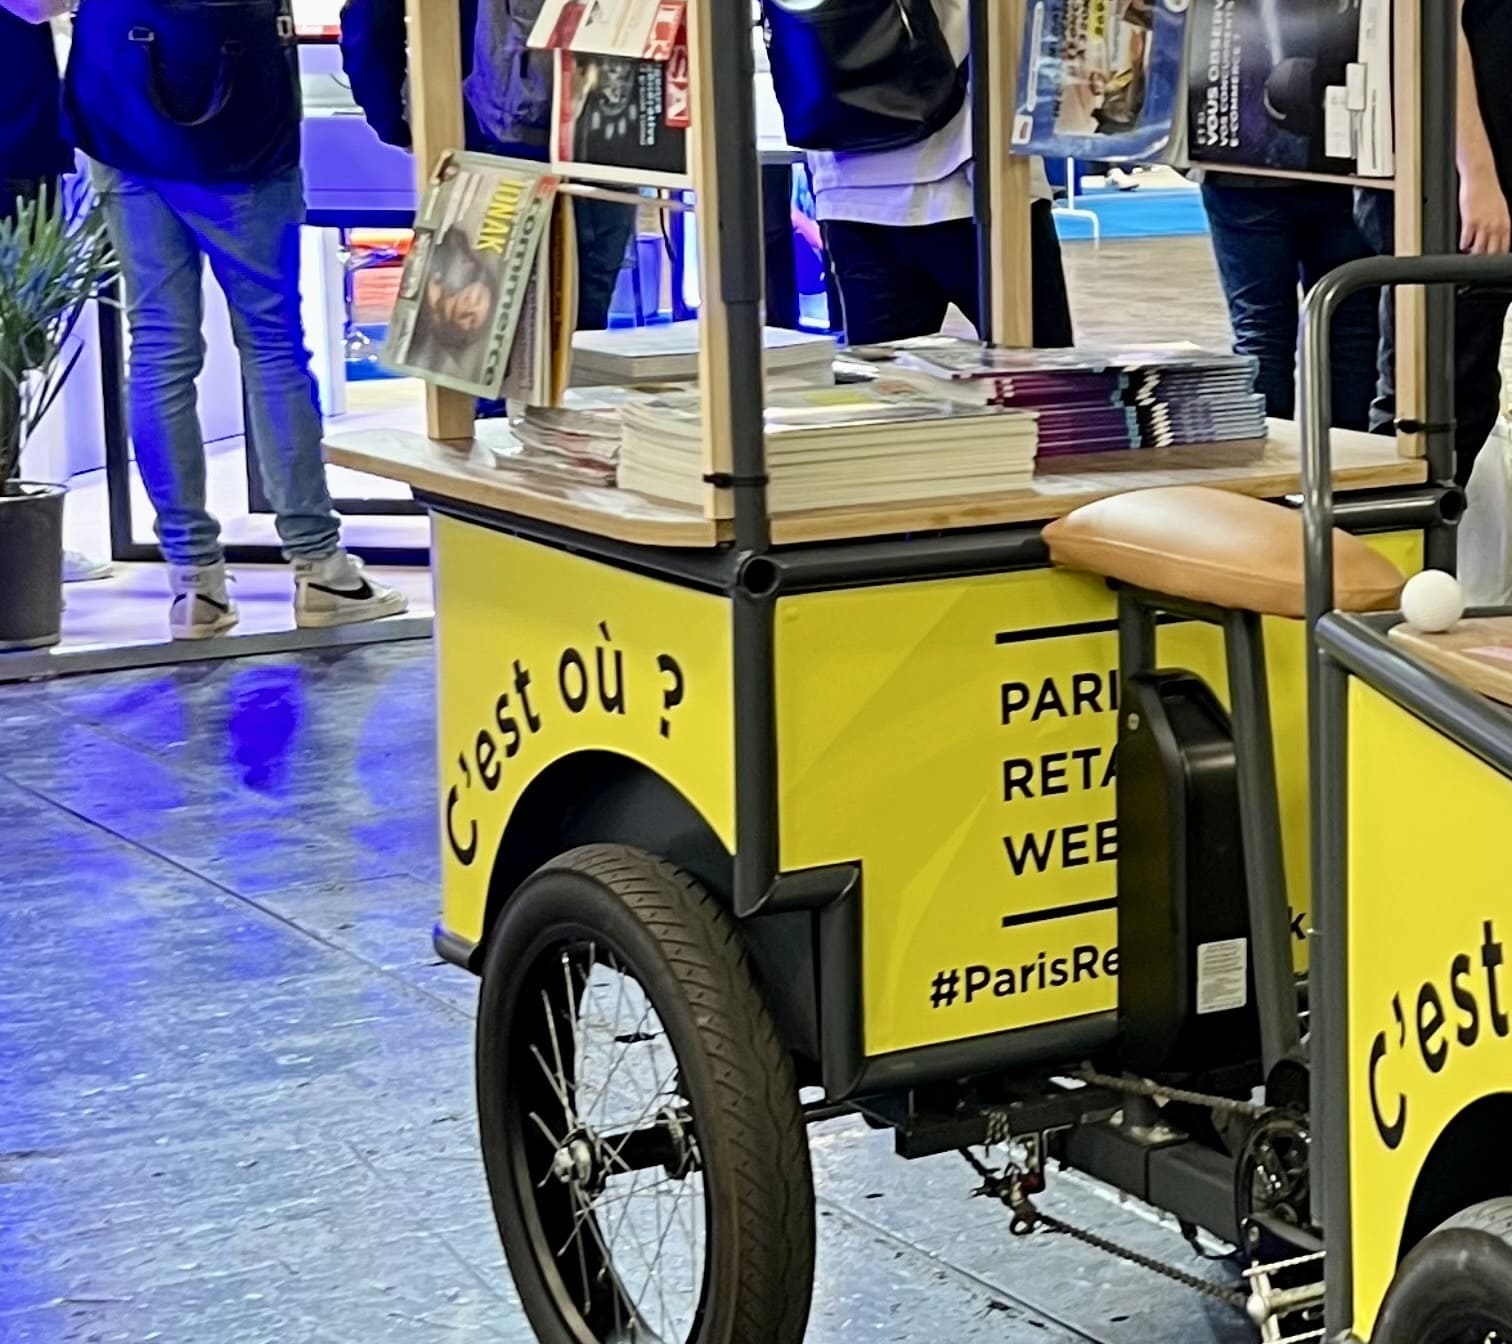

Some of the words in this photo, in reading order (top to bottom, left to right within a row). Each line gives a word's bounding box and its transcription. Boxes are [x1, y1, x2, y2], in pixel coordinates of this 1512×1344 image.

[1207, 85, 1220, 146] VOUS
[1001, 669, 1118, 725] PARI
[444, 657, 542, 868] C'est
[556, 620, 627, 717] où
[655, 652, 686, 739] ?
[1003, 818, 1118, 877] WEE
[930, 944, 1120, 1009] #ParisRe
[1368, 920, 1510, 1150] C'est
